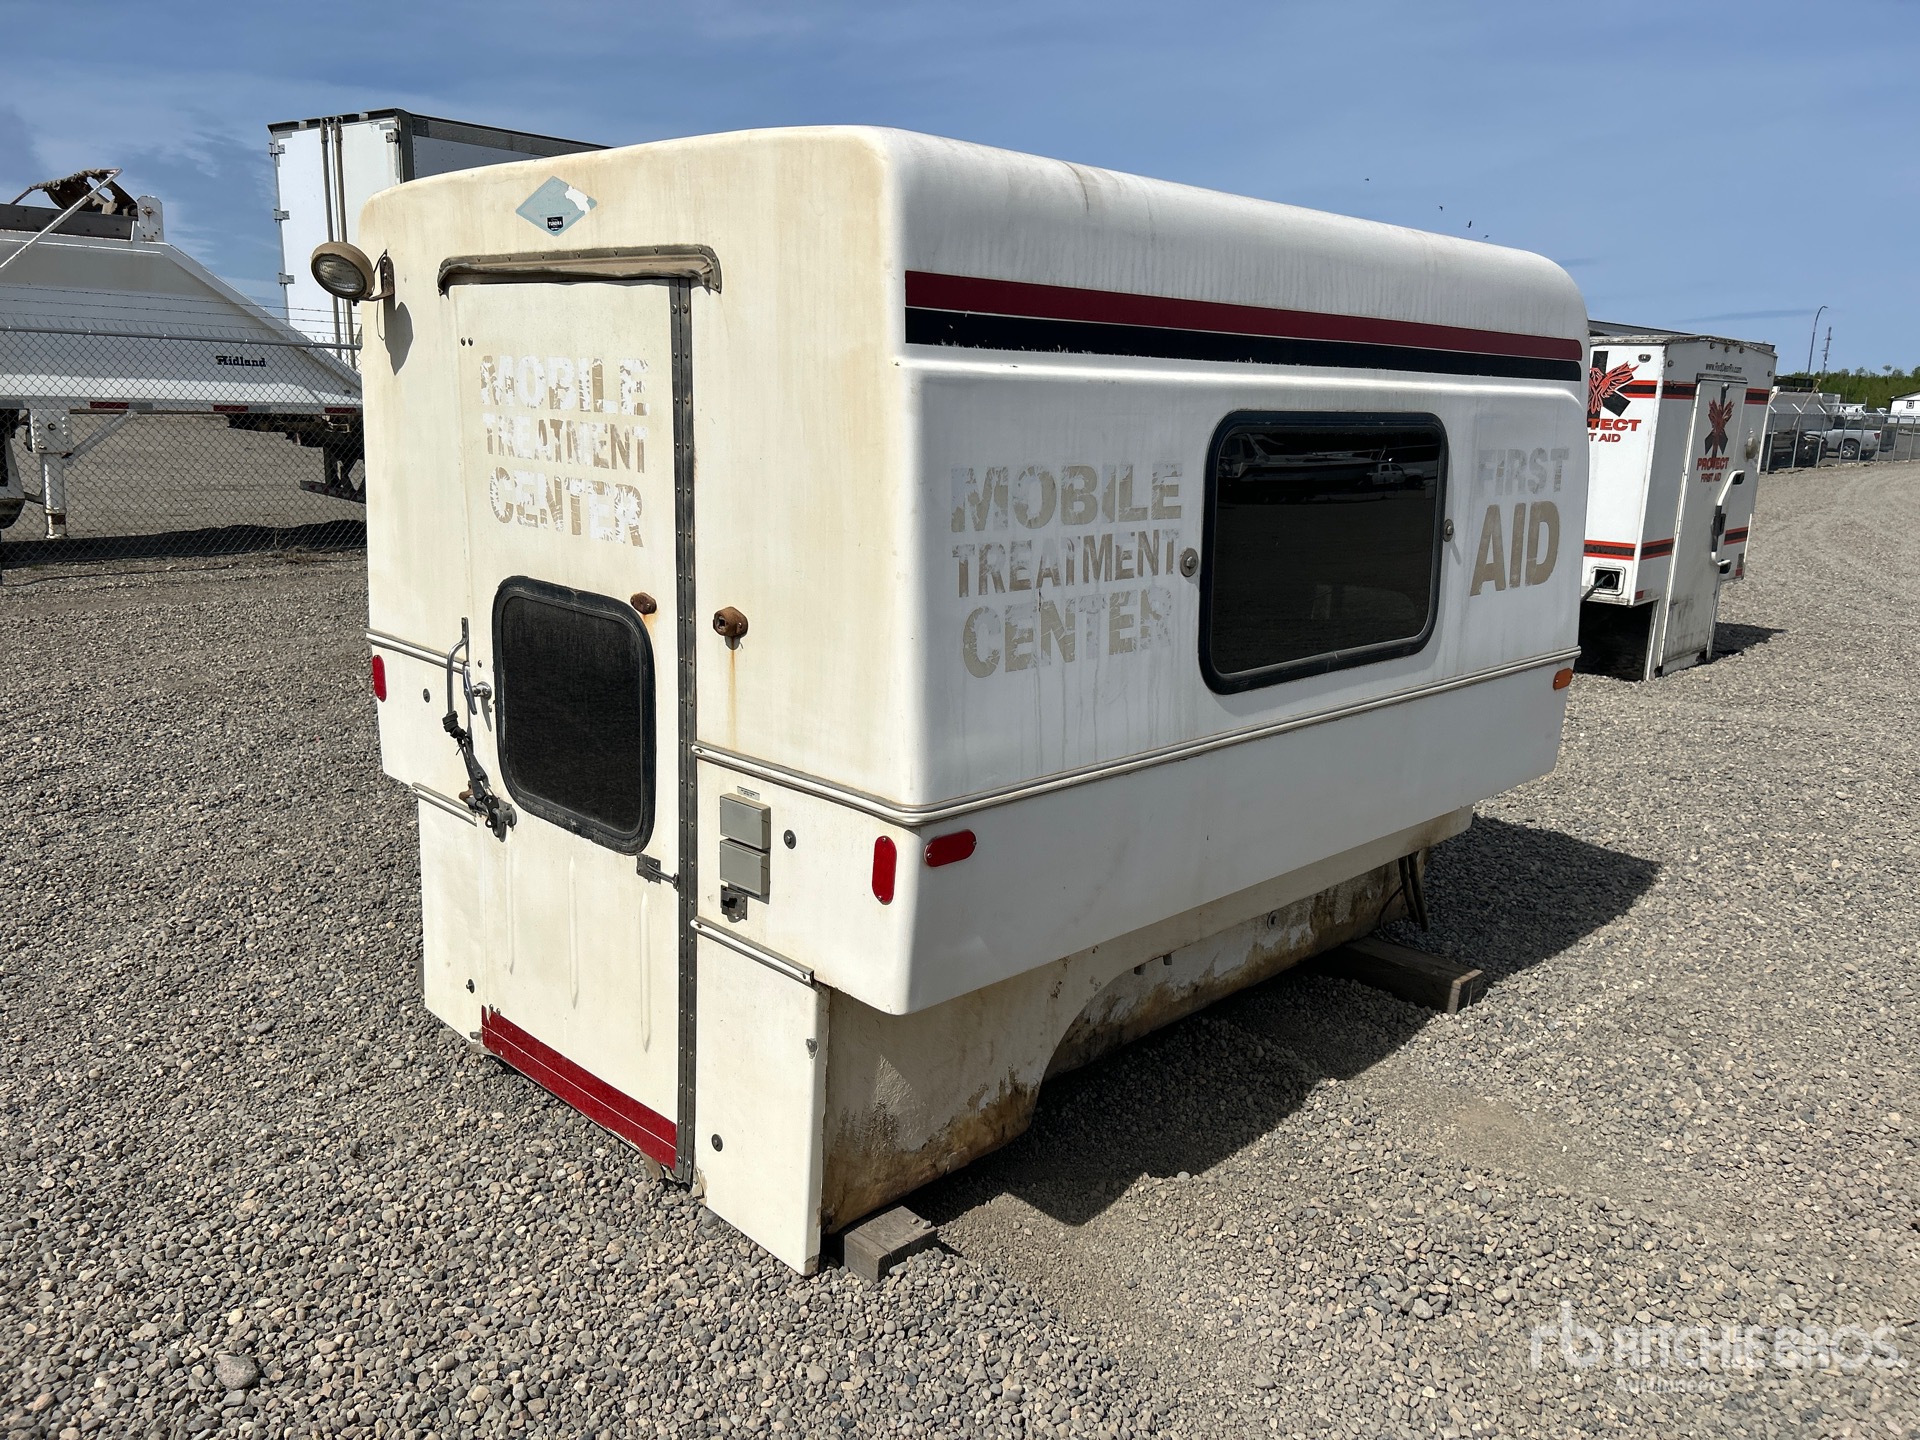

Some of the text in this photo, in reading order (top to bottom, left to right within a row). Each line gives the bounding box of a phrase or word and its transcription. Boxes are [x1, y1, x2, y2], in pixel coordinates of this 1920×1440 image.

[215, 355, 267, 367] Midland
[480, 355, 650, 416] MOBILE
[483, 413, 648, 473] TREATMENT
[1588, 418, 1642, 431] TECT
[1598, 433, 1621, 442] AID
[1477, 447, 1570, 496] FIRST
[1696, 457, 1730, 471] PROTECT
[1700, 472, 1722, 483] FIRST AID
[490, 467, 643, 547] CENTER
[951, 462, 1183, 533] MOBILE
[952, 528, 1180, 598] TREATMENT
[1470, 501, 1560, 597] AID
[963, 586, 1173, 678] CENTER
